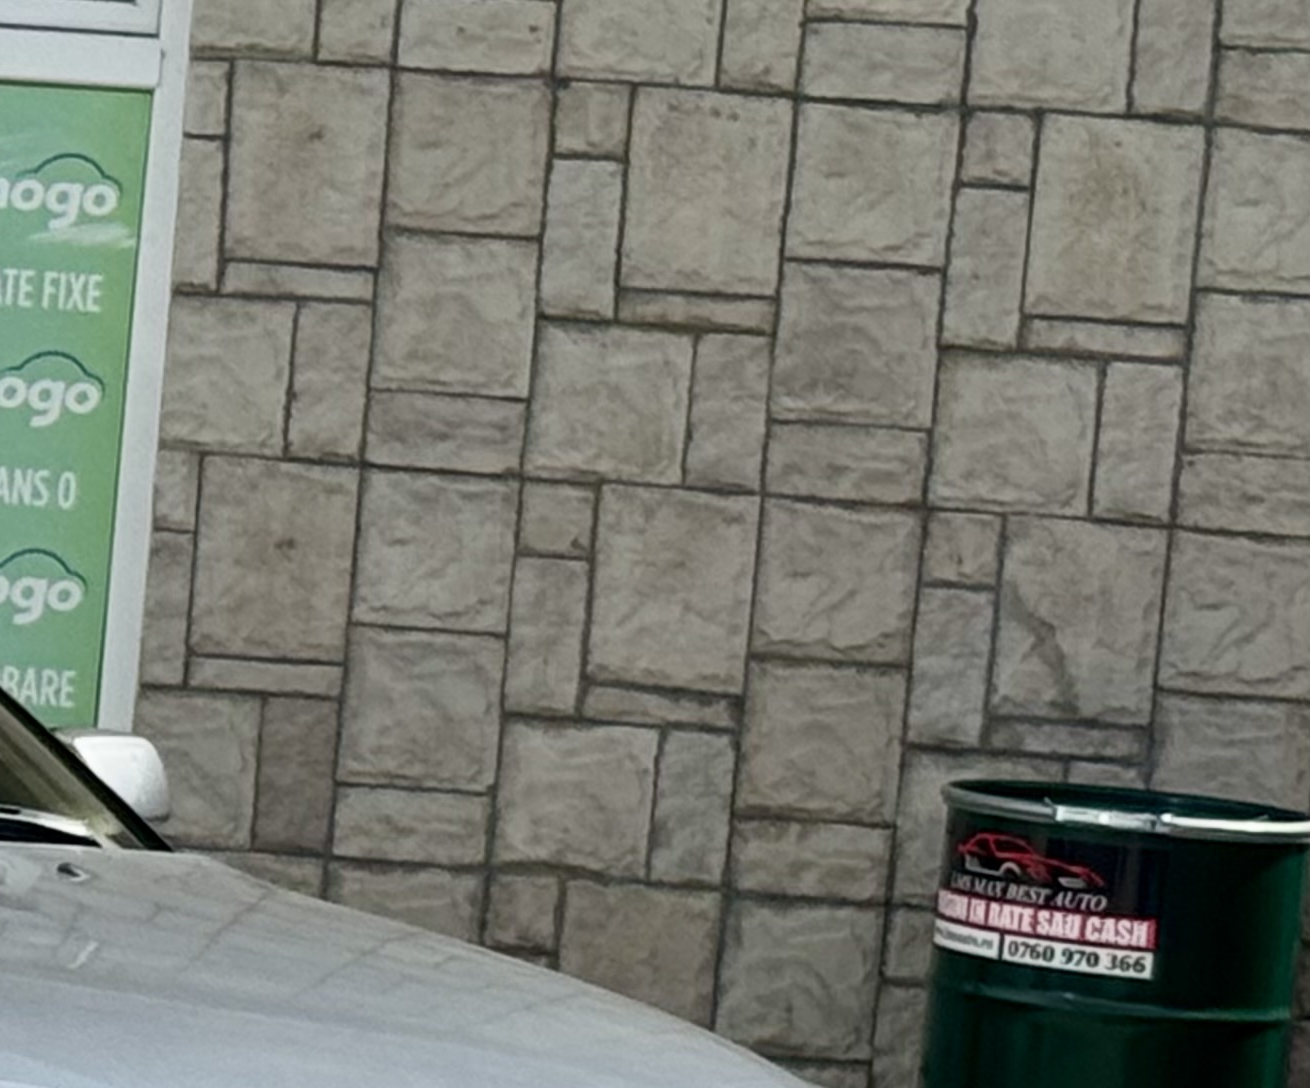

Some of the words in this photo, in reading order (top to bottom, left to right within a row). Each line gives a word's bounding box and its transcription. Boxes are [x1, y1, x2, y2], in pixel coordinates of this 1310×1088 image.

[41, 271, 104, 313] FIXE
[1006, 883, 1053, 906] BEST
[1049, 890, 1109, 912] AUTO
[987, 901, 1037, 935] RATE
[1036, 909, 1082, 940] SAU
[1085, 916, 1149, 949] CASH
[1007, 940, 1055, 963] 0760
[1060, 947, 1100, 968] 970
[1104, 953, 1147, 974] 366
